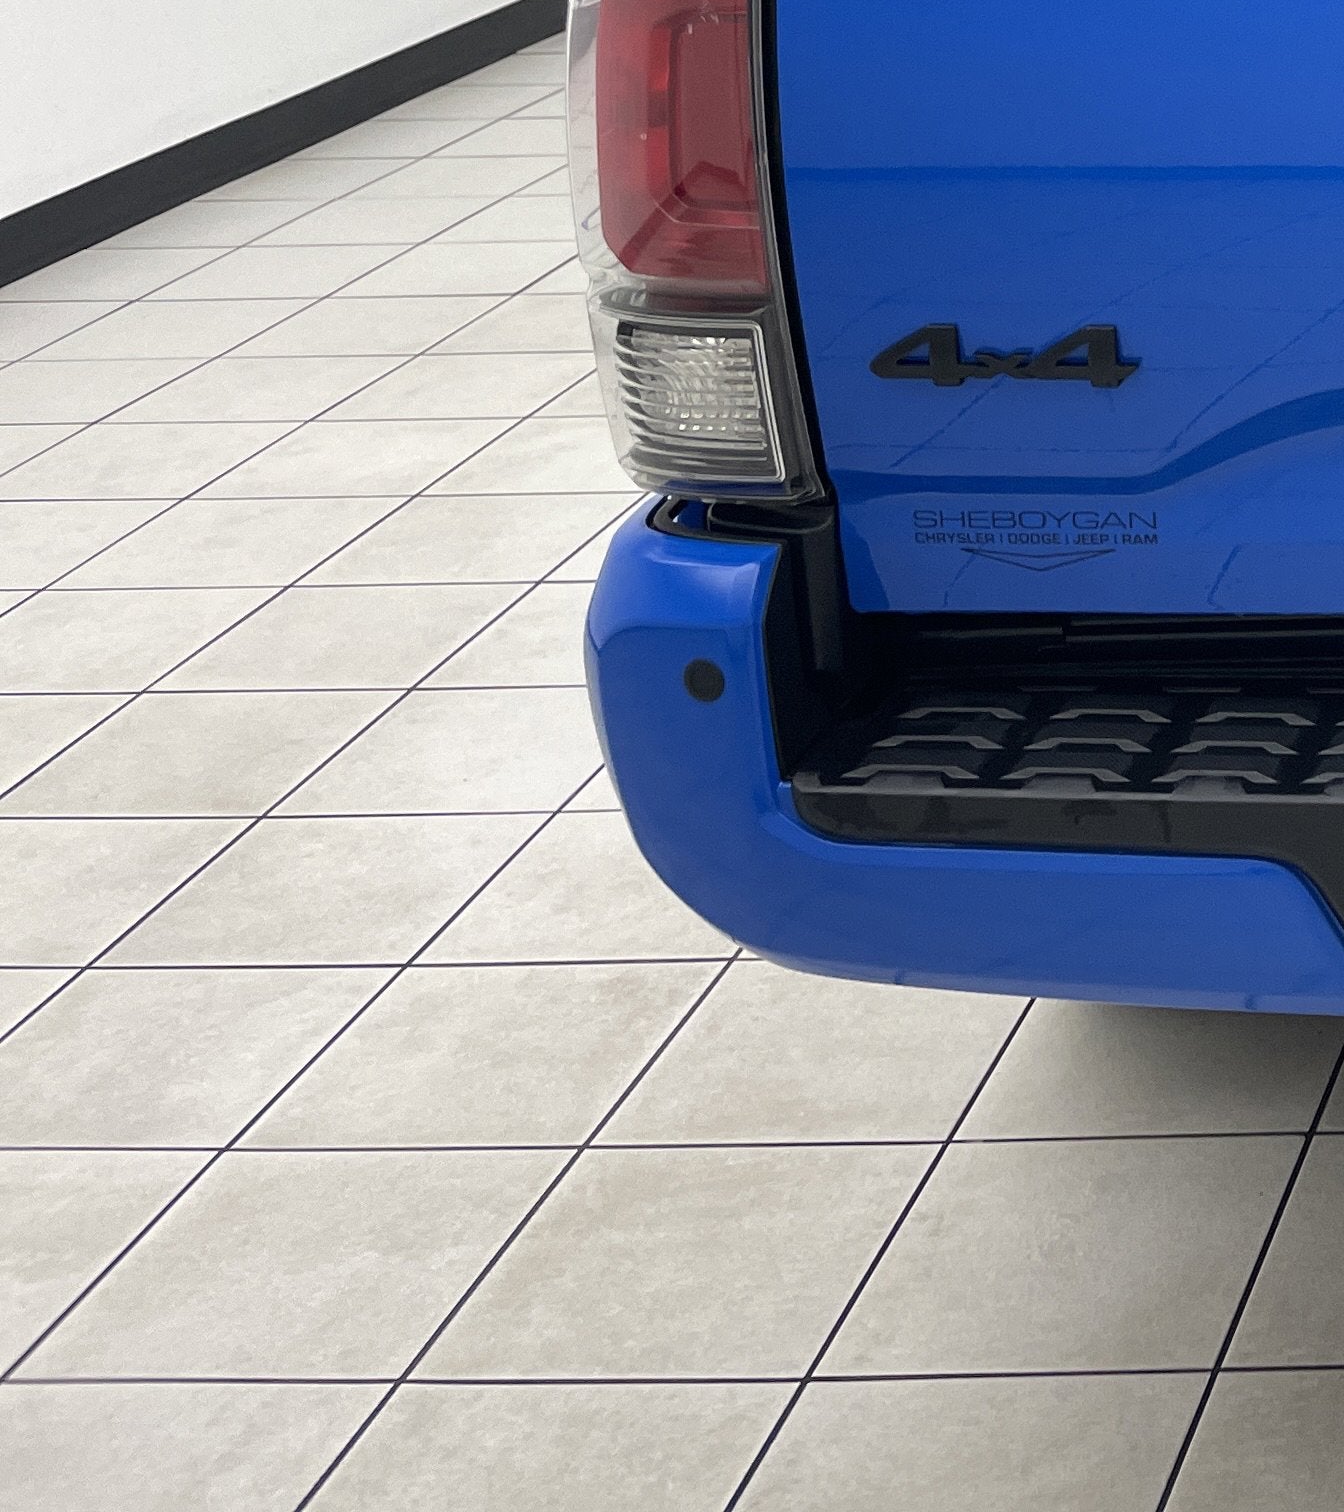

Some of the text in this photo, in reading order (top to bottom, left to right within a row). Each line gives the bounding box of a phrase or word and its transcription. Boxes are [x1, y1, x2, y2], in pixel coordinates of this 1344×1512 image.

[912, 510, 1157, 529] SHEBOYGAN
[914, 532, 1159, 545] CHRYSLER DODGE JEEP RAM
